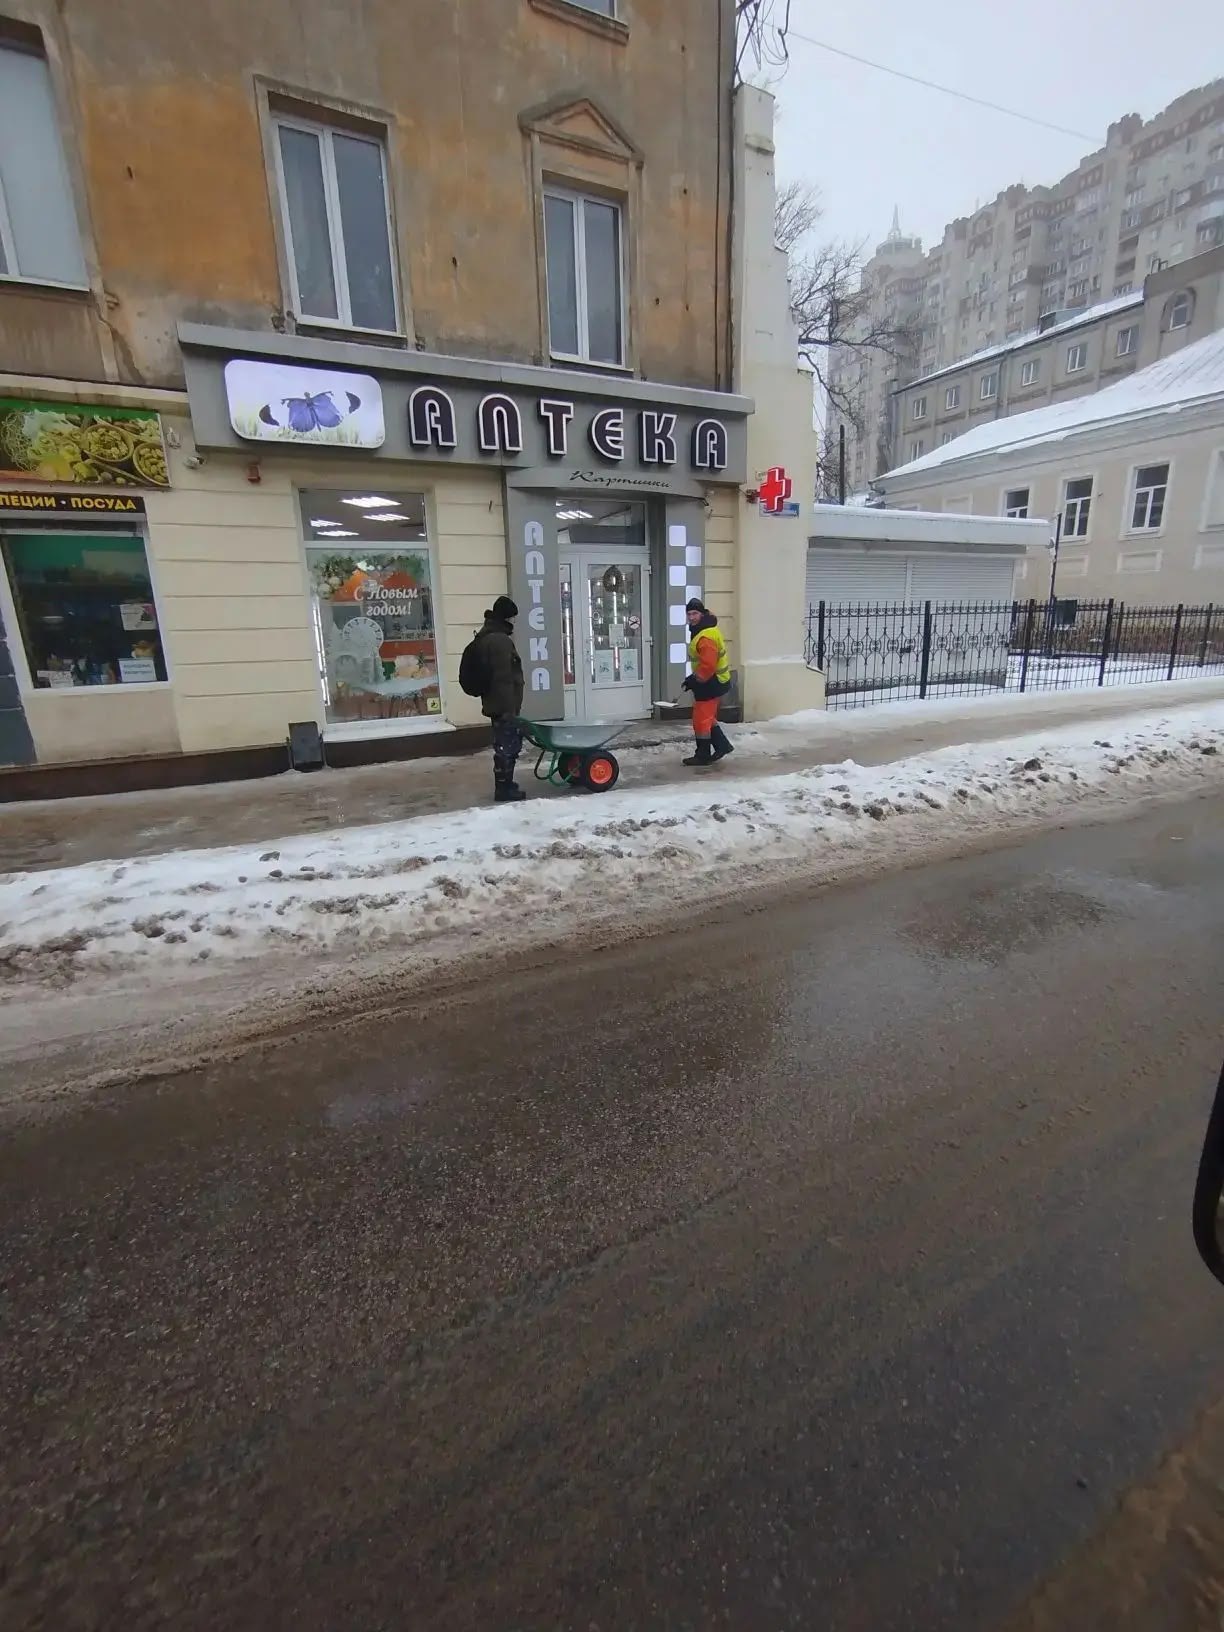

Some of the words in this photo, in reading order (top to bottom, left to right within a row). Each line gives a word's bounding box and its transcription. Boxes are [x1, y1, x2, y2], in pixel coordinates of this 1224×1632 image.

[408, 385, 728, 470] АПТЕКА
[0, 494, 57, 508] ПЕЦИИ
[70, 497, 137, 510] ПОСУДА
[353, 585, 364, 601] С
[367, 584, 418, 600] Новым
[366, 600, 411, 617] годом!
[524, 520, 550, 691] АПТЕКА
